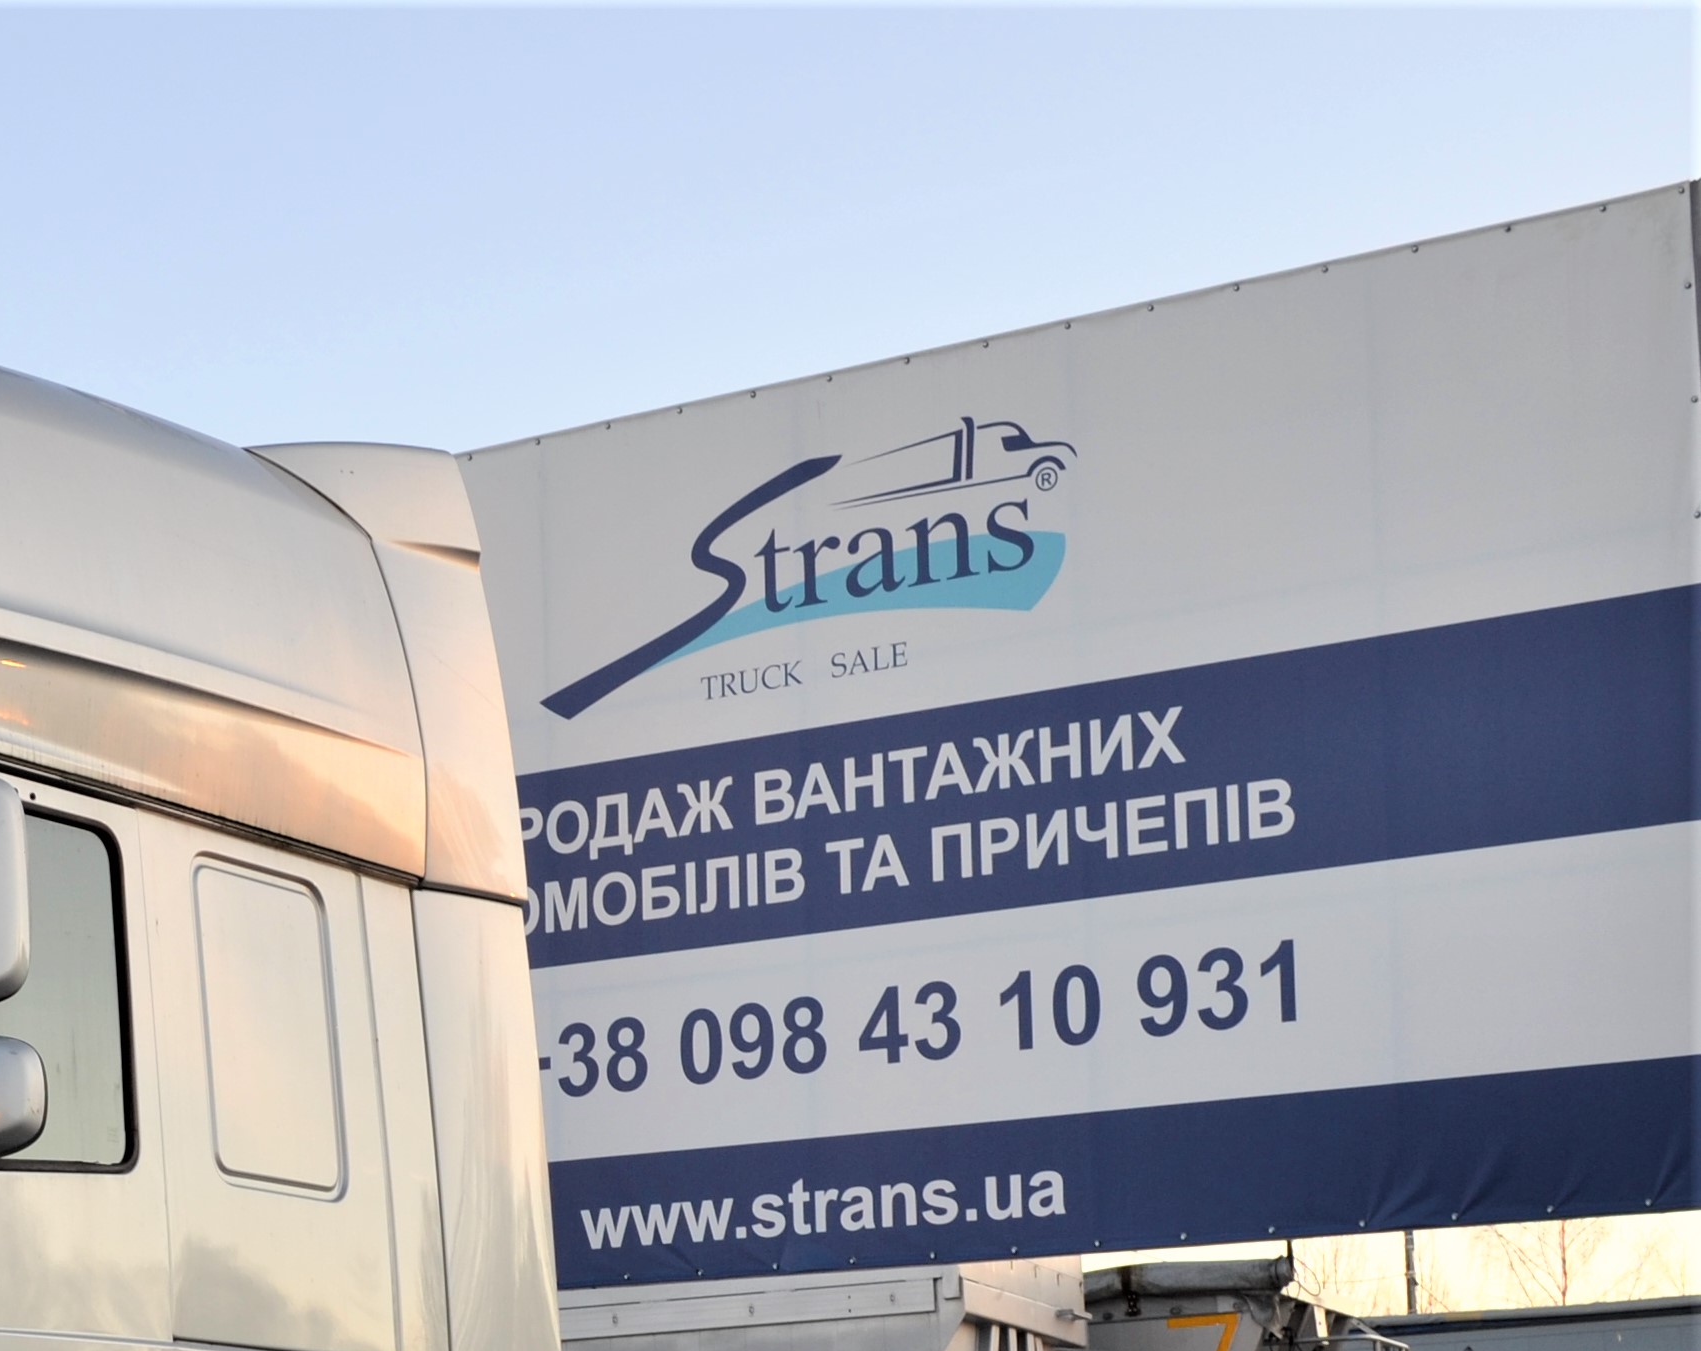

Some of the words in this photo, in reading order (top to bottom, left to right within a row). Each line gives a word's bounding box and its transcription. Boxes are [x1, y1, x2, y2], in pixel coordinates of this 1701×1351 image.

[539, 454, 1035, 720] Strans
[701, 659, 802, 700] TRUCK
[831, 641, 909, 680] SALE
[753, 706, 1186, 826] ВАНТАЖНИХ
[826, 832, 910, 895] ТА
[931, 778, 1295, 881] ПРИЧЕПІВ
[680, 996, 827, 1084] 098
[859, 980, 961, 1064] 43
[999, 964, 1101, 1051] 10
[1137, 938, 1299, 1038] 931
[581, 1170, 1066, 1251] www.strans.ua
